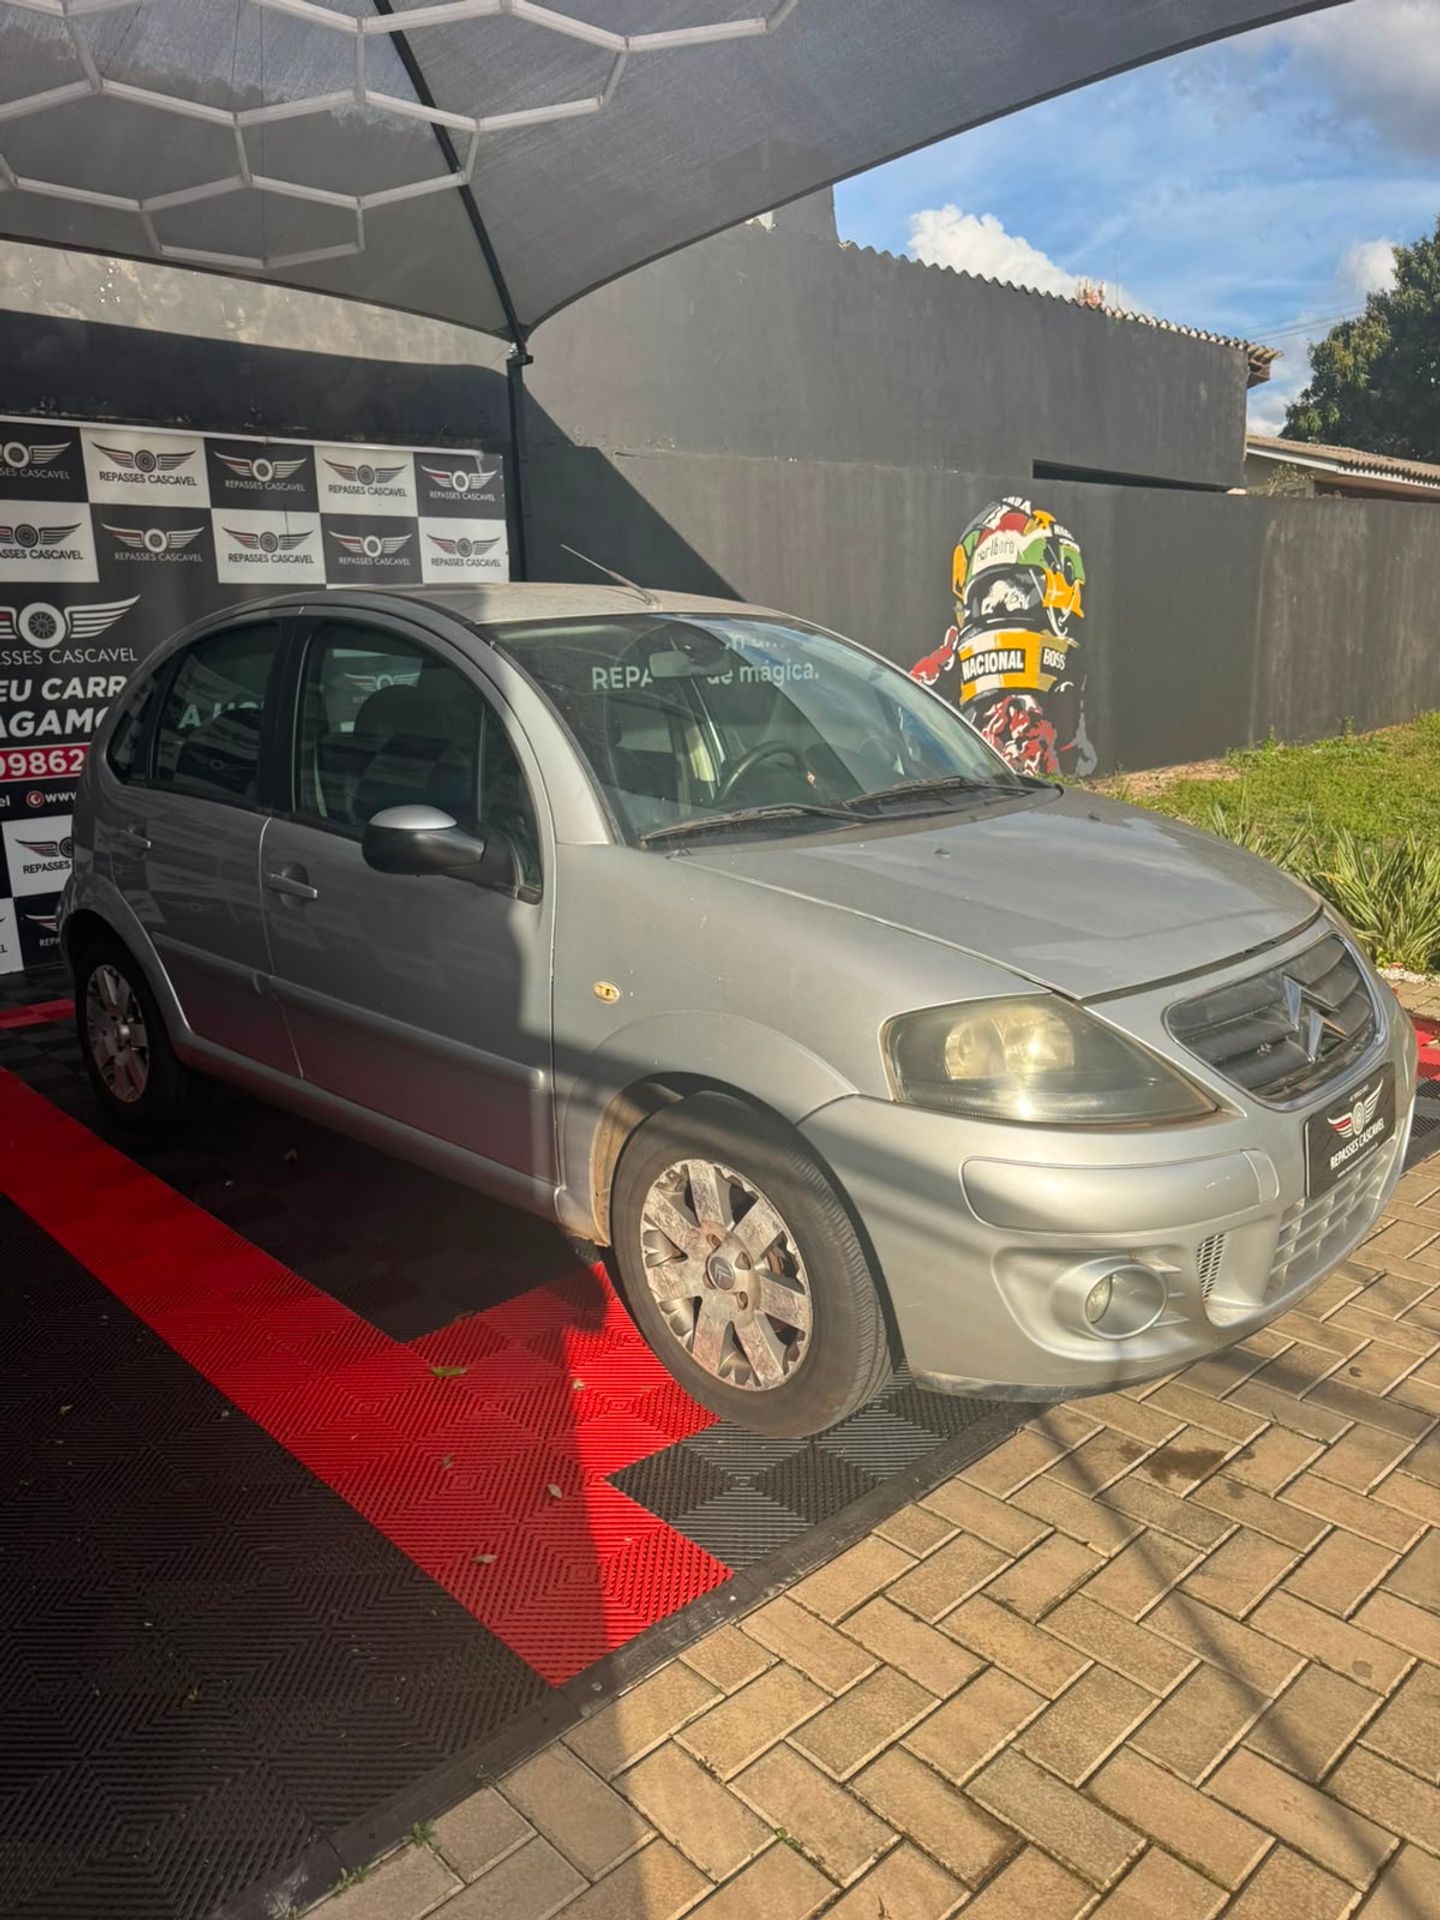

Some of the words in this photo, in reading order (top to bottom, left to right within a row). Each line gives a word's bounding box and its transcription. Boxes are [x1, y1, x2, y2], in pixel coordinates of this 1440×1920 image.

[20, 469, 71, 480] CASCAVEL
[99, 471, 148, 484] REPASSES
[149, 474, 198, 486] CASCAVEL
[225, 480, 263, 490] REPASSES
[265, 482, 306, 492] CASCAVEL
[328, 484, 366, 495] REPASSES
[367, 486, 407, 497] CASCAVEL
[429, 491, 461, 500] REPASSES
[462, 492, 496, 501] CASCAVEL
[29, 549, 84, 560] CASCAVEL
[115, 552, 156, 562] REPASSES
[158, 552, 203, 563] CASCAVEL
[228, 553, 269, 563] REPASSES
[270, 554, 314, 564] CASCAVEL
[339, 557, 373, 566] REPASSES
[375, 558, 411, 566] CASCAVEL
[431, 557, 465, 566] REPASSES
[466, 558, 502, 567] CASCAVEL
[0, 650, 43, 665] SSES
[49, 647, 138, 664] CASCAVEL
[1042, 648, 1066, 671] BOSS
[961, 649, 1024, 681] NACIONAL
[592, 667, 653, 690] REPA
[740, 660, 820, 686] mágica.
[41, 675, 128, 700] CARR
[23, 860, 71, 875] REPASSES
[1330, 1138, 1359, 1170] REPASSES
[1359, 1117, 1385, 1147] CASCAVEL
